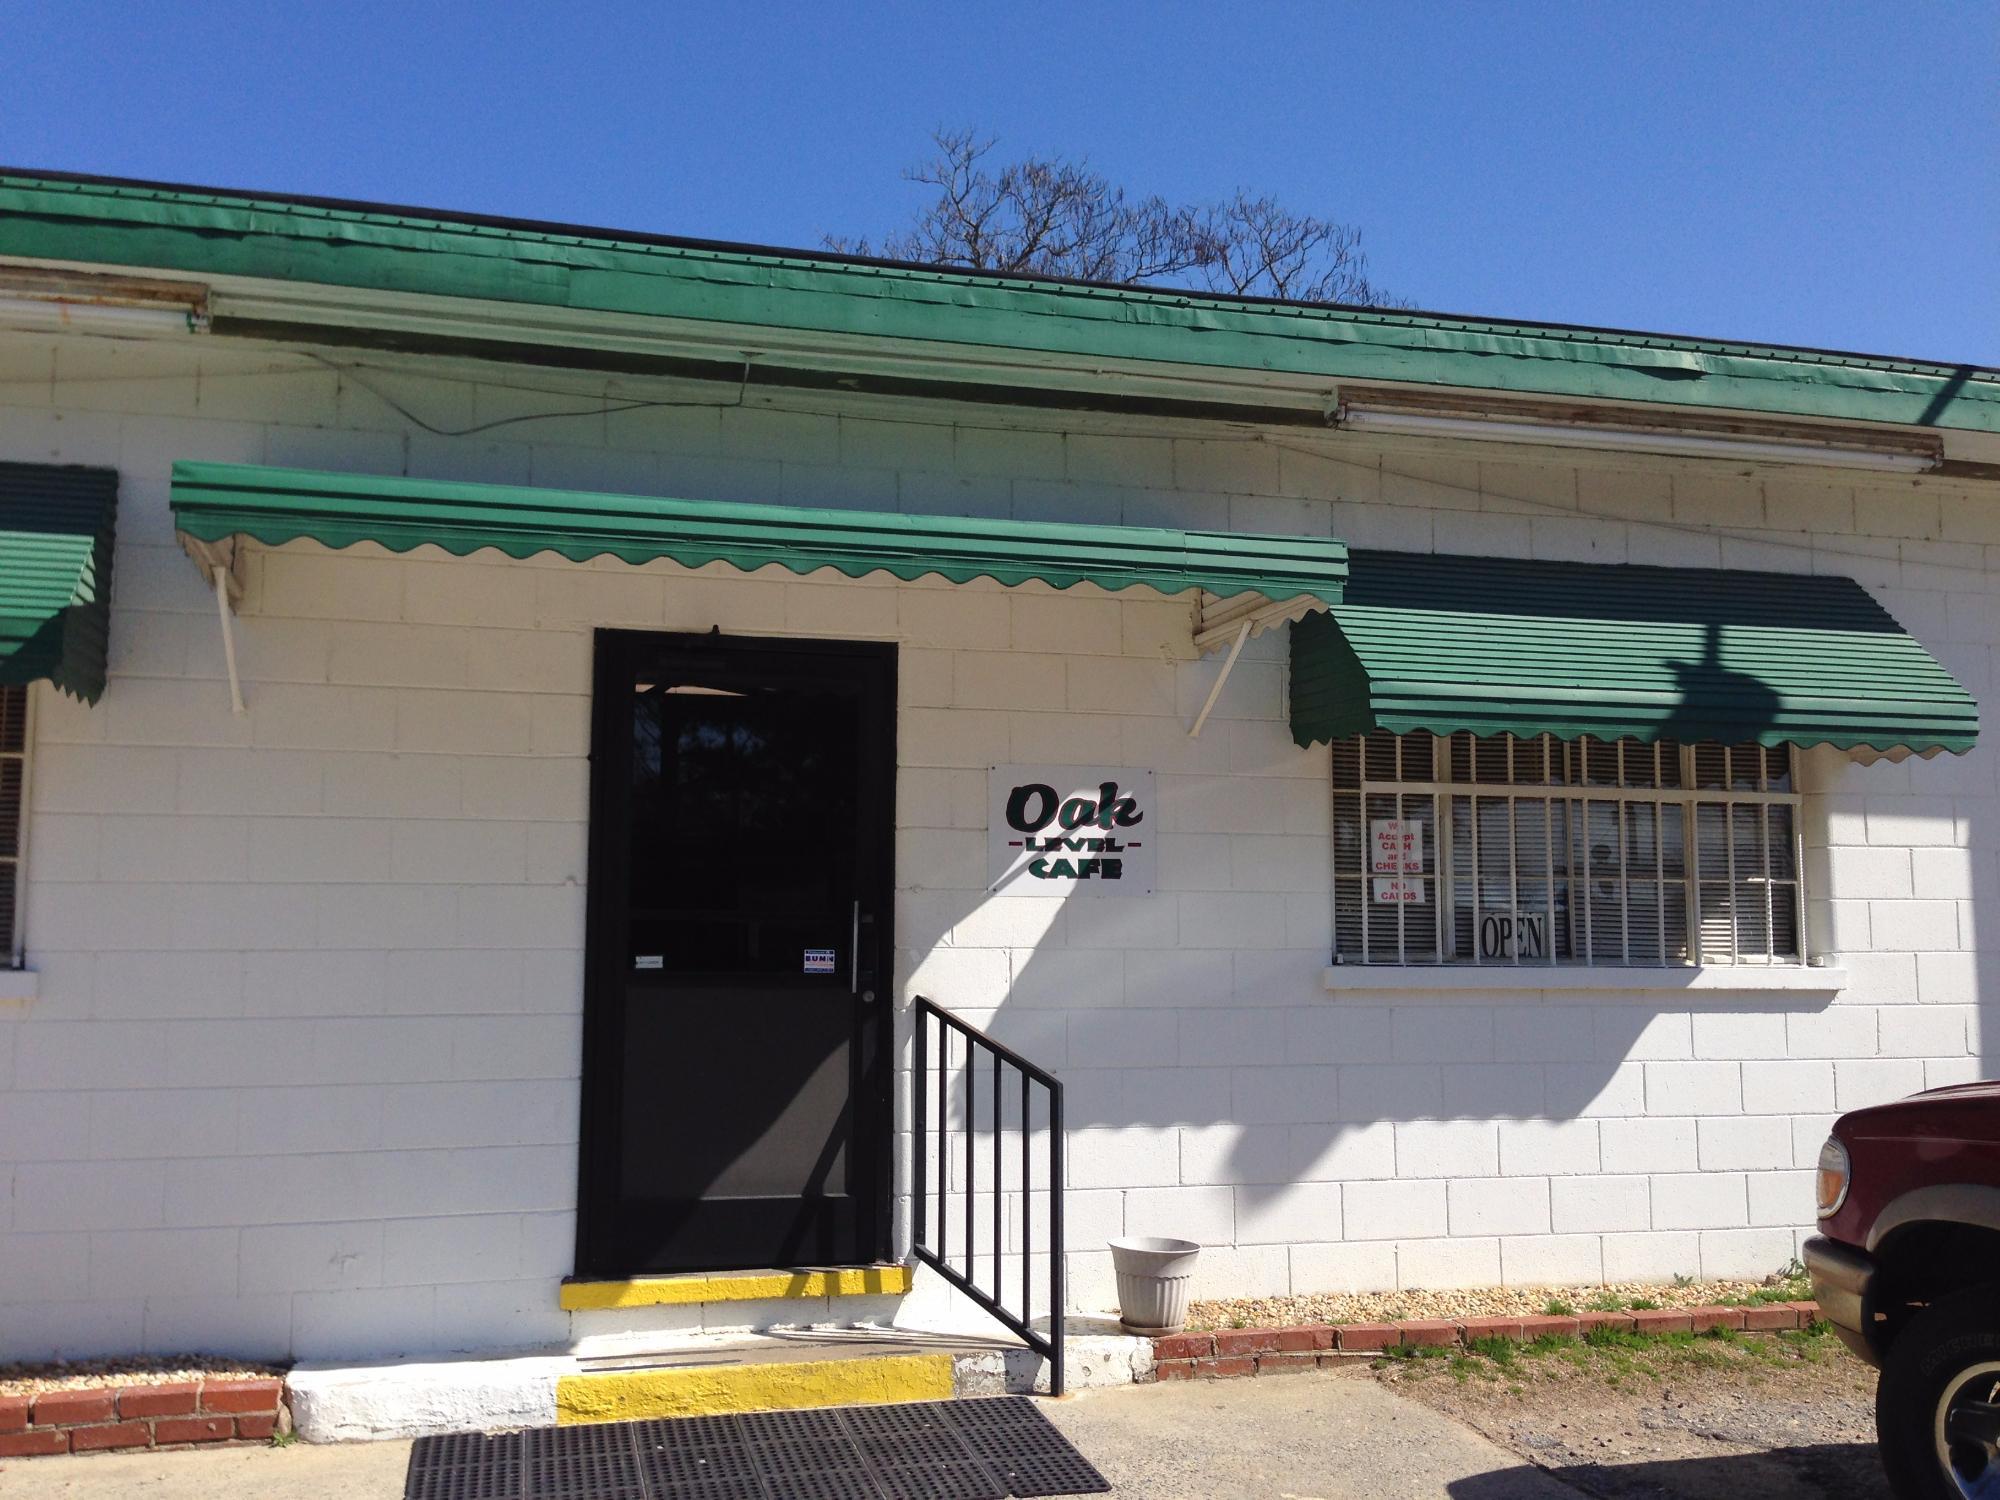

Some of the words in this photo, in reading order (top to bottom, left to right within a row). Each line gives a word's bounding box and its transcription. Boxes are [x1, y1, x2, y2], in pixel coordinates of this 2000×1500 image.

[1006, 782, 1144, 833] Oak
[1378, 832, 1415, 842] Accpt
[1381, 842, 1412, 850] CAH
[1028, 858, 1123, 880] CAFE
[1375, 862, 1419, 870] CHEKS
[1481, 916, 1542, 958] OPEN
